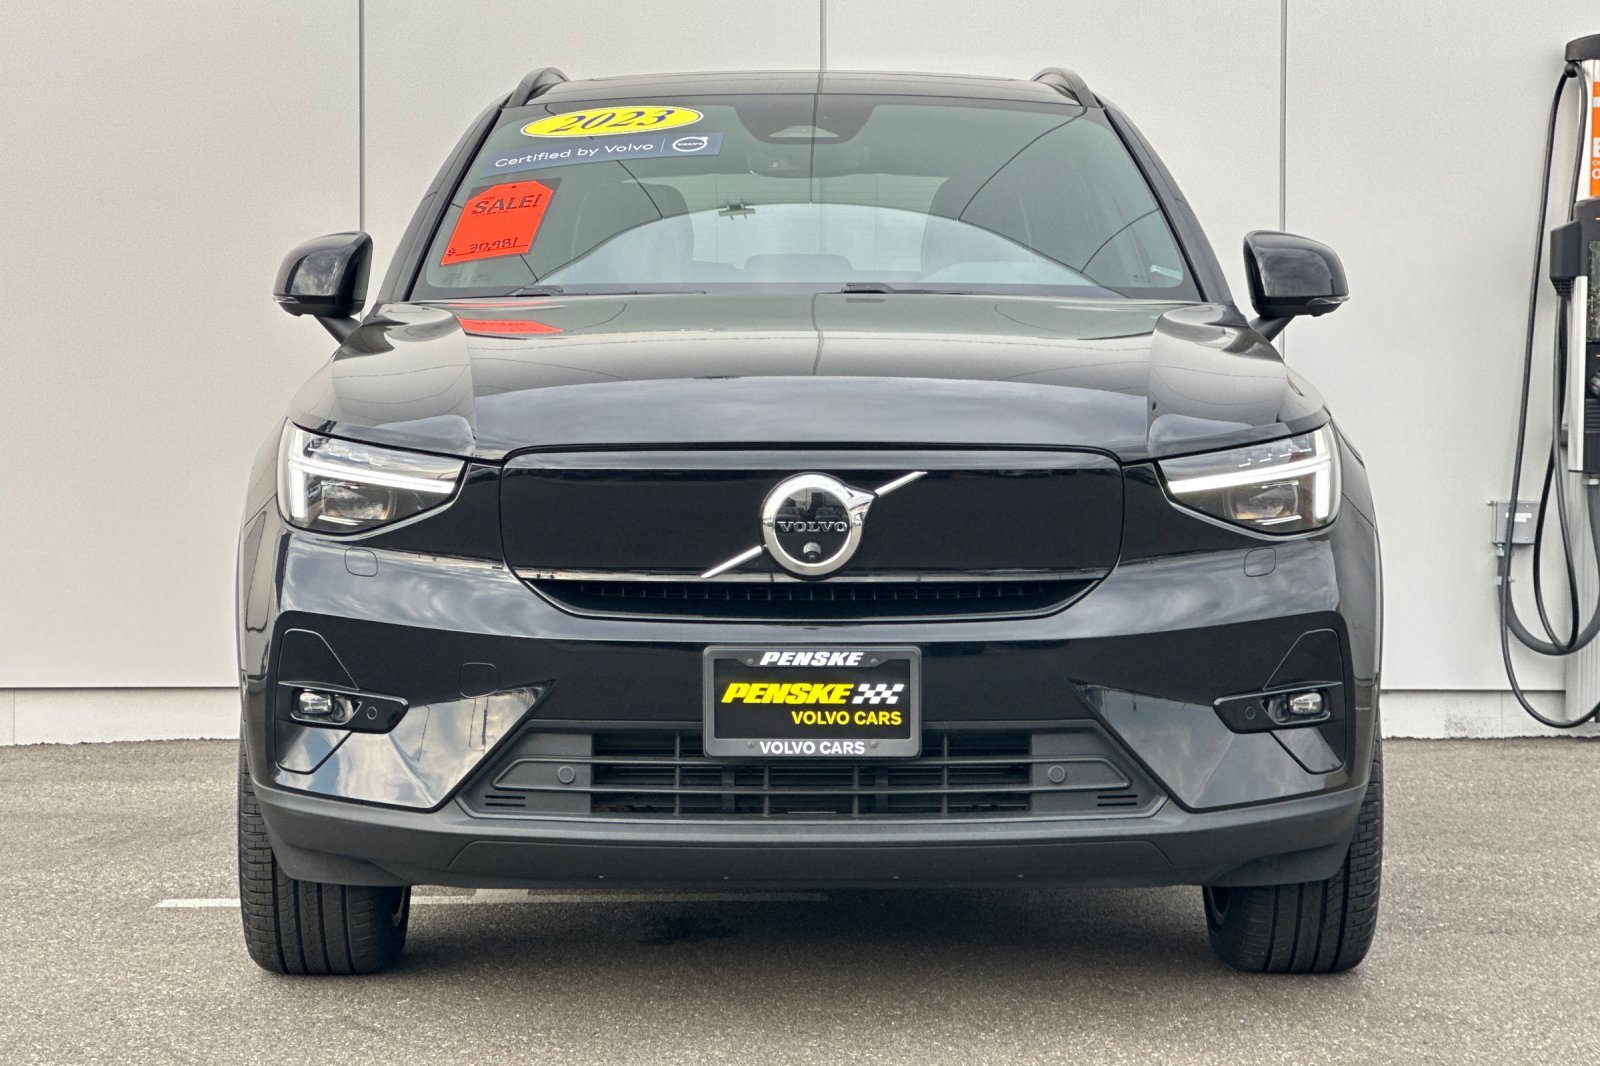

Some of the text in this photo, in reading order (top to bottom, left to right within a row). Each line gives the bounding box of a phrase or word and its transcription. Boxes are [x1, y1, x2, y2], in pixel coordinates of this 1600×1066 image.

[548, 110, 676, 133] 2023
[494, 142, 655, 168] Certified by Volvo
[472, 193, 543, 215] SALE!
[777, 521, 848, 532] VOLVO
[759, 651, 864, 667] PENSKE
[721, 682, 854, 705] PENSKE
[791, 710, 903, 726] VOLVO CARS
[759, 740, 865, 755] VOLVO CARS
